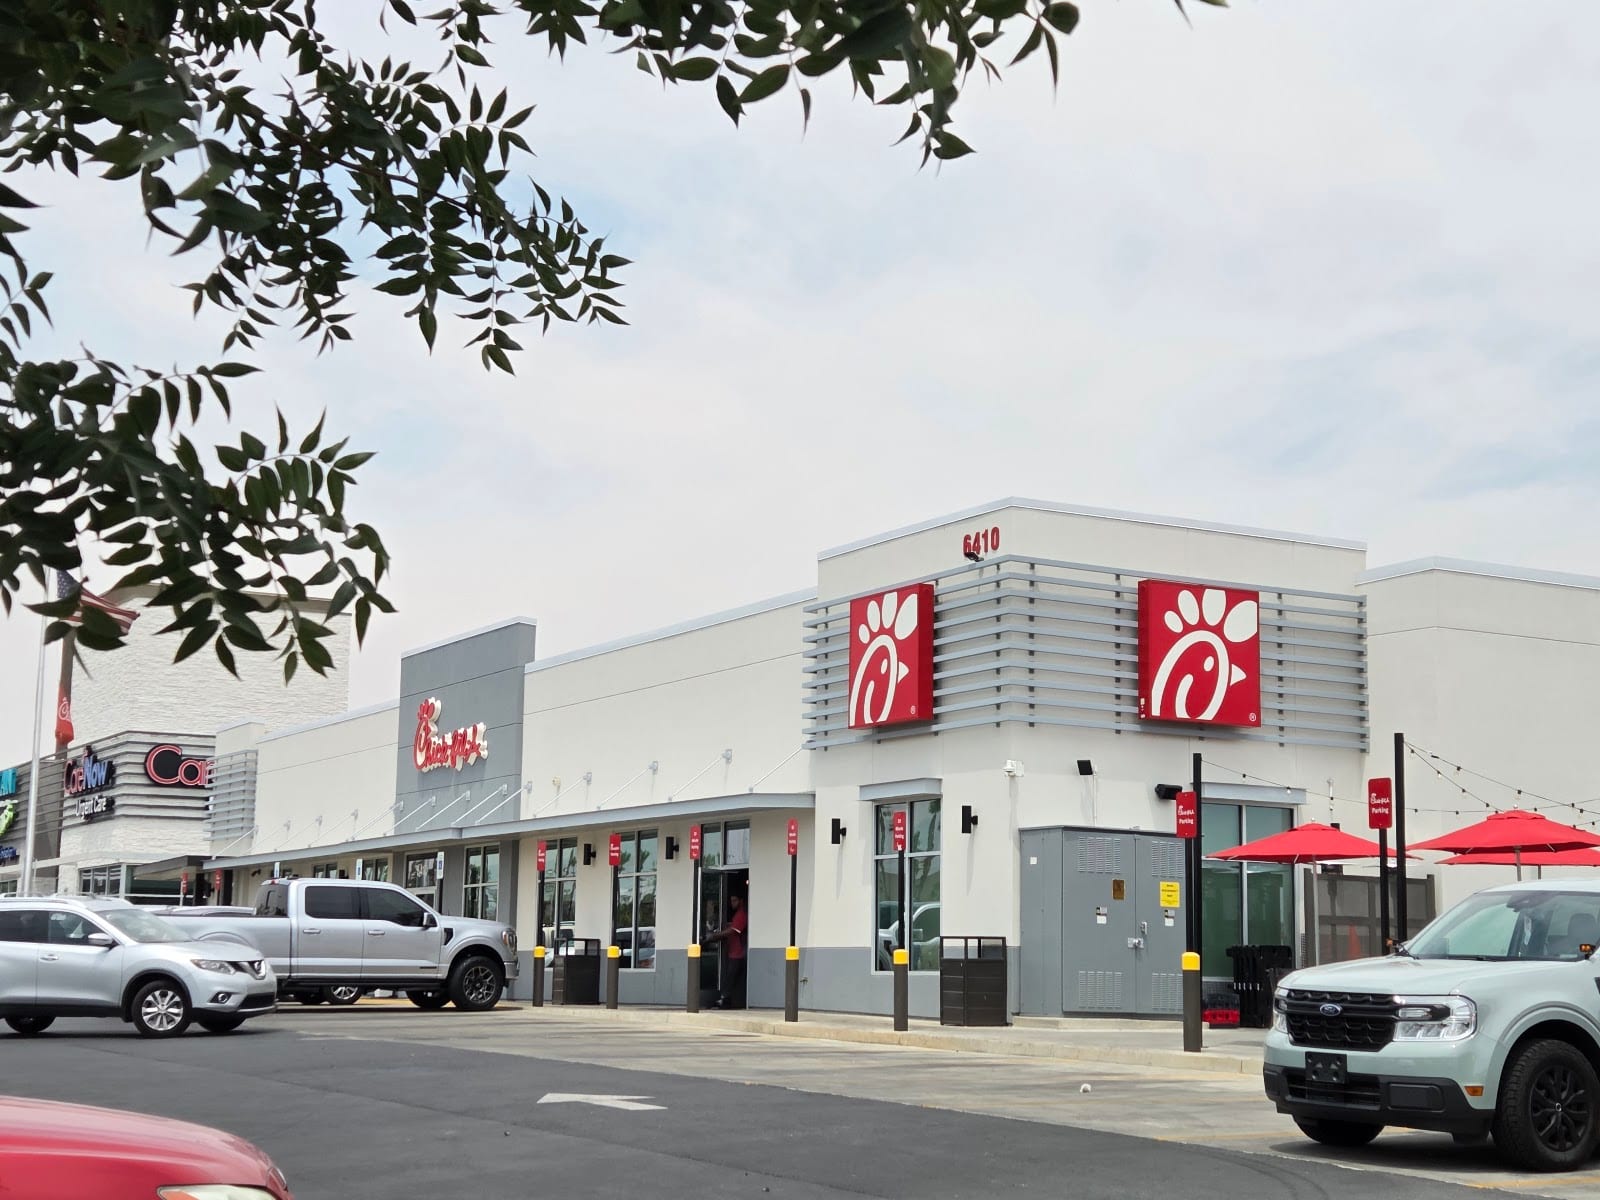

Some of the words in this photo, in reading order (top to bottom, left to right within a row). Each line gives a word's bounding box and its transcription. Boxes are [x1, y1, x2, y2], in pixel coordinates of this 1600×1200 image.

[963, 526, 1000, 557] 6410
[75, 799, 94, 819] Urgent
[94, 795, 107, 813] Care
